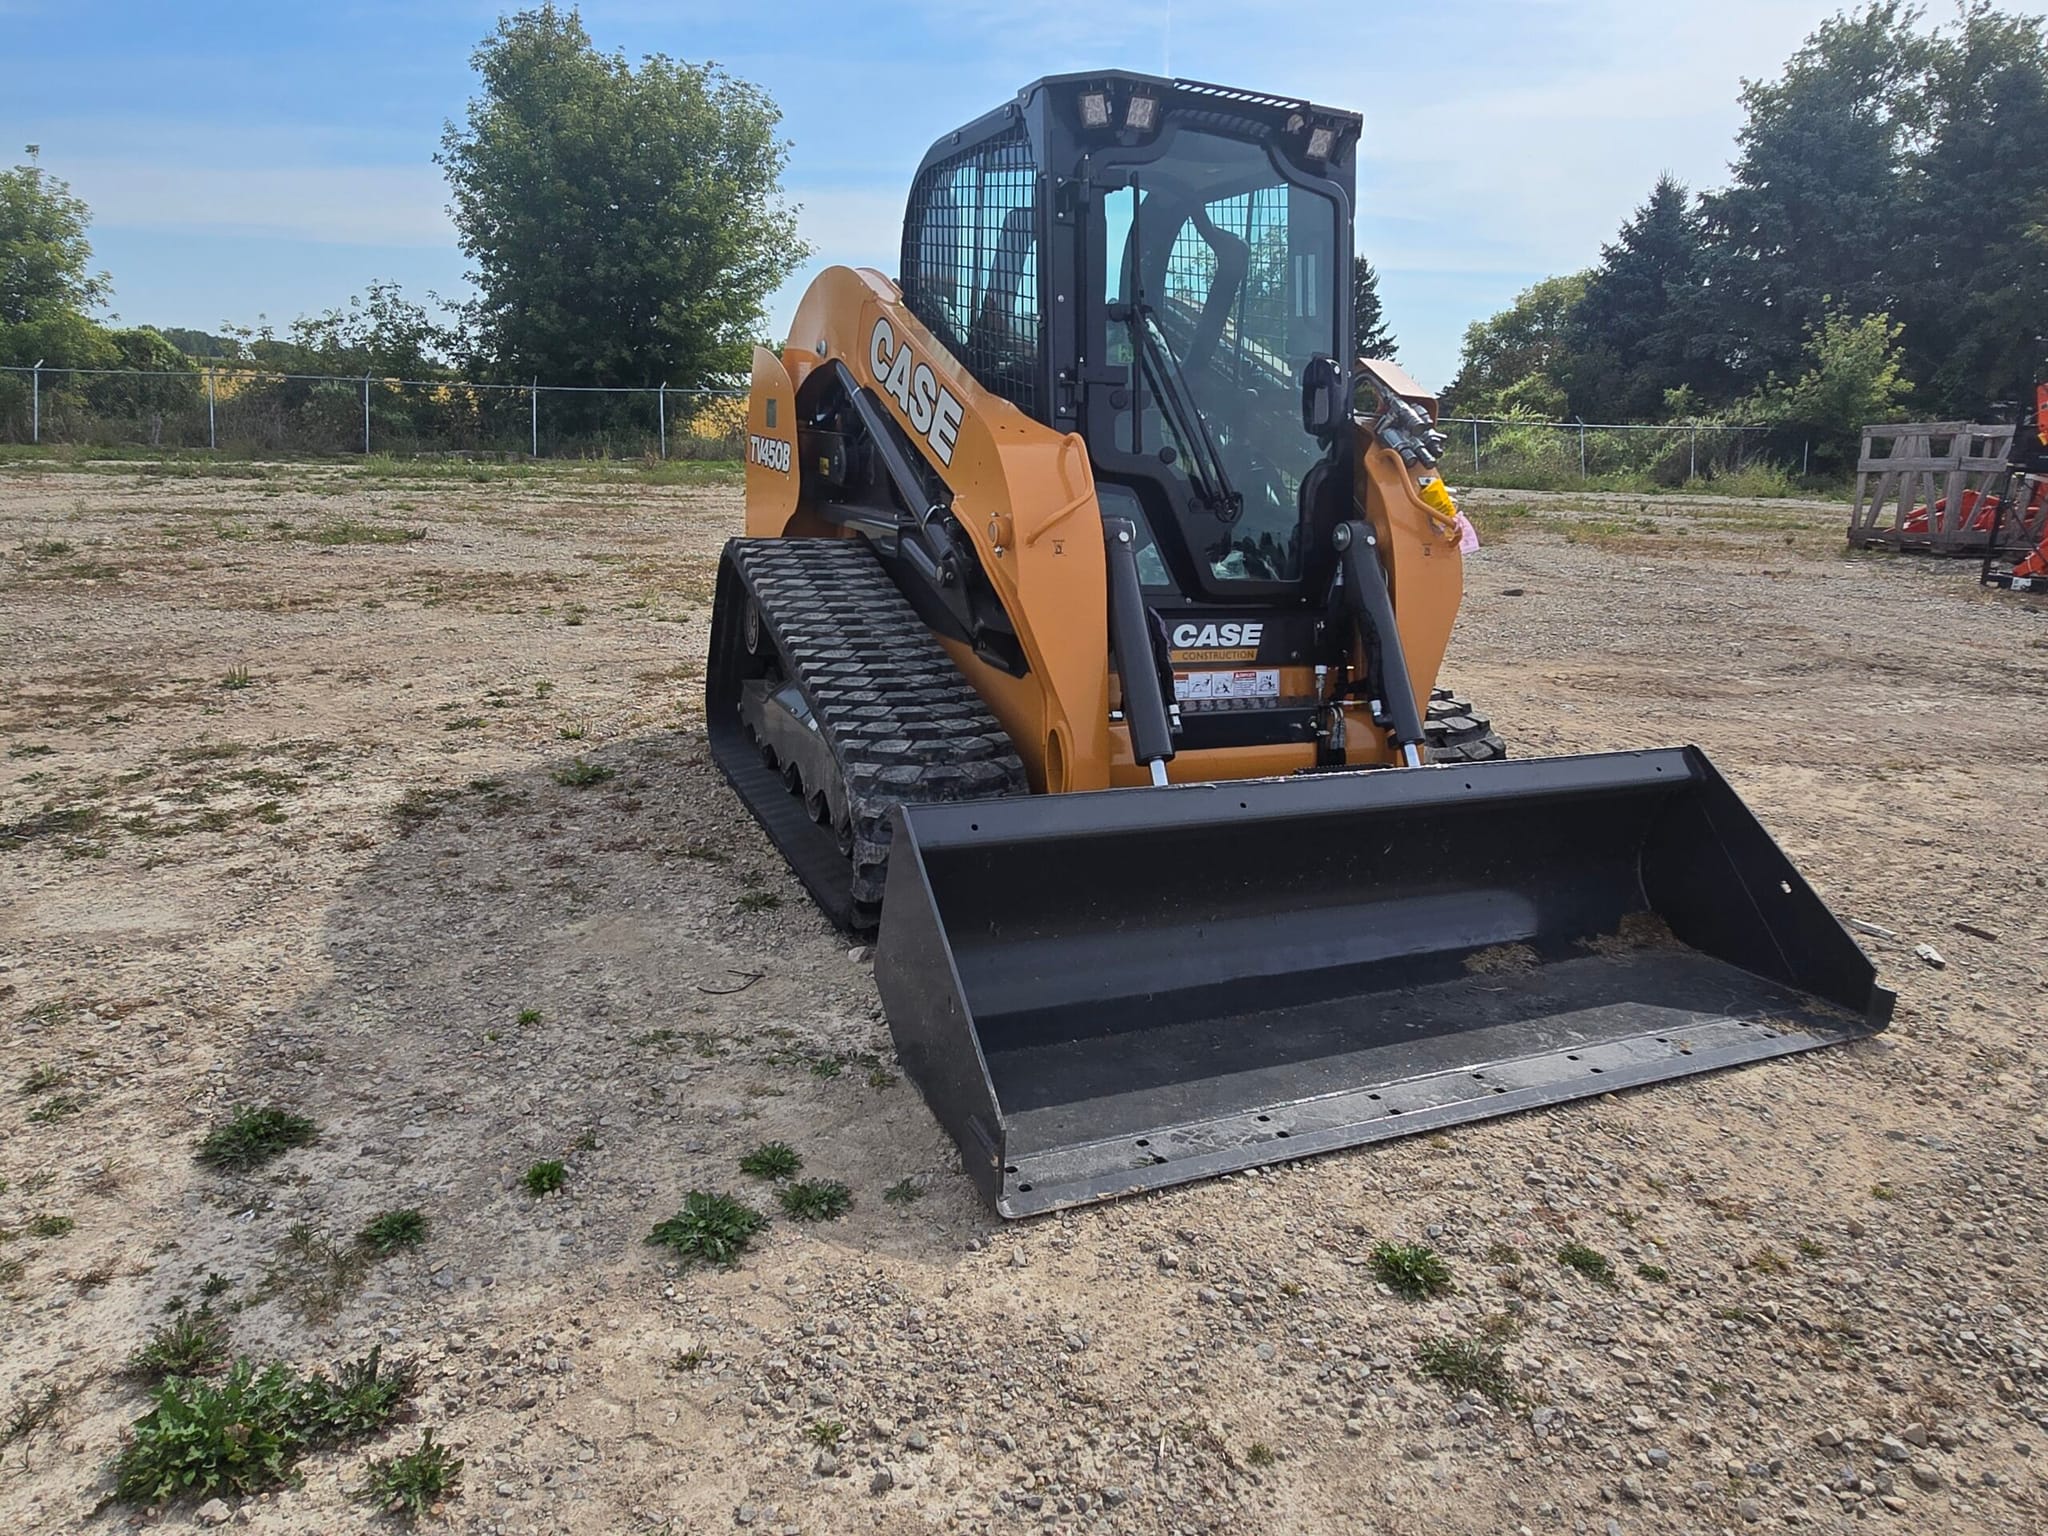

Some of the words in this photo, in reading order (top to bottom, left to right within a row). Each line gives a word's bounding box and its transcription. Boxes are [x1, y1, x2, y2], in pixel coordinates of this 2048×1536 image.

[870, 317, 964, 468] CASE
[750, 434, 791, 473] TV450B
[1172, 623, 1264, 648] CASE
[1182, 650, 1255, 661] CONSTRUCTION
